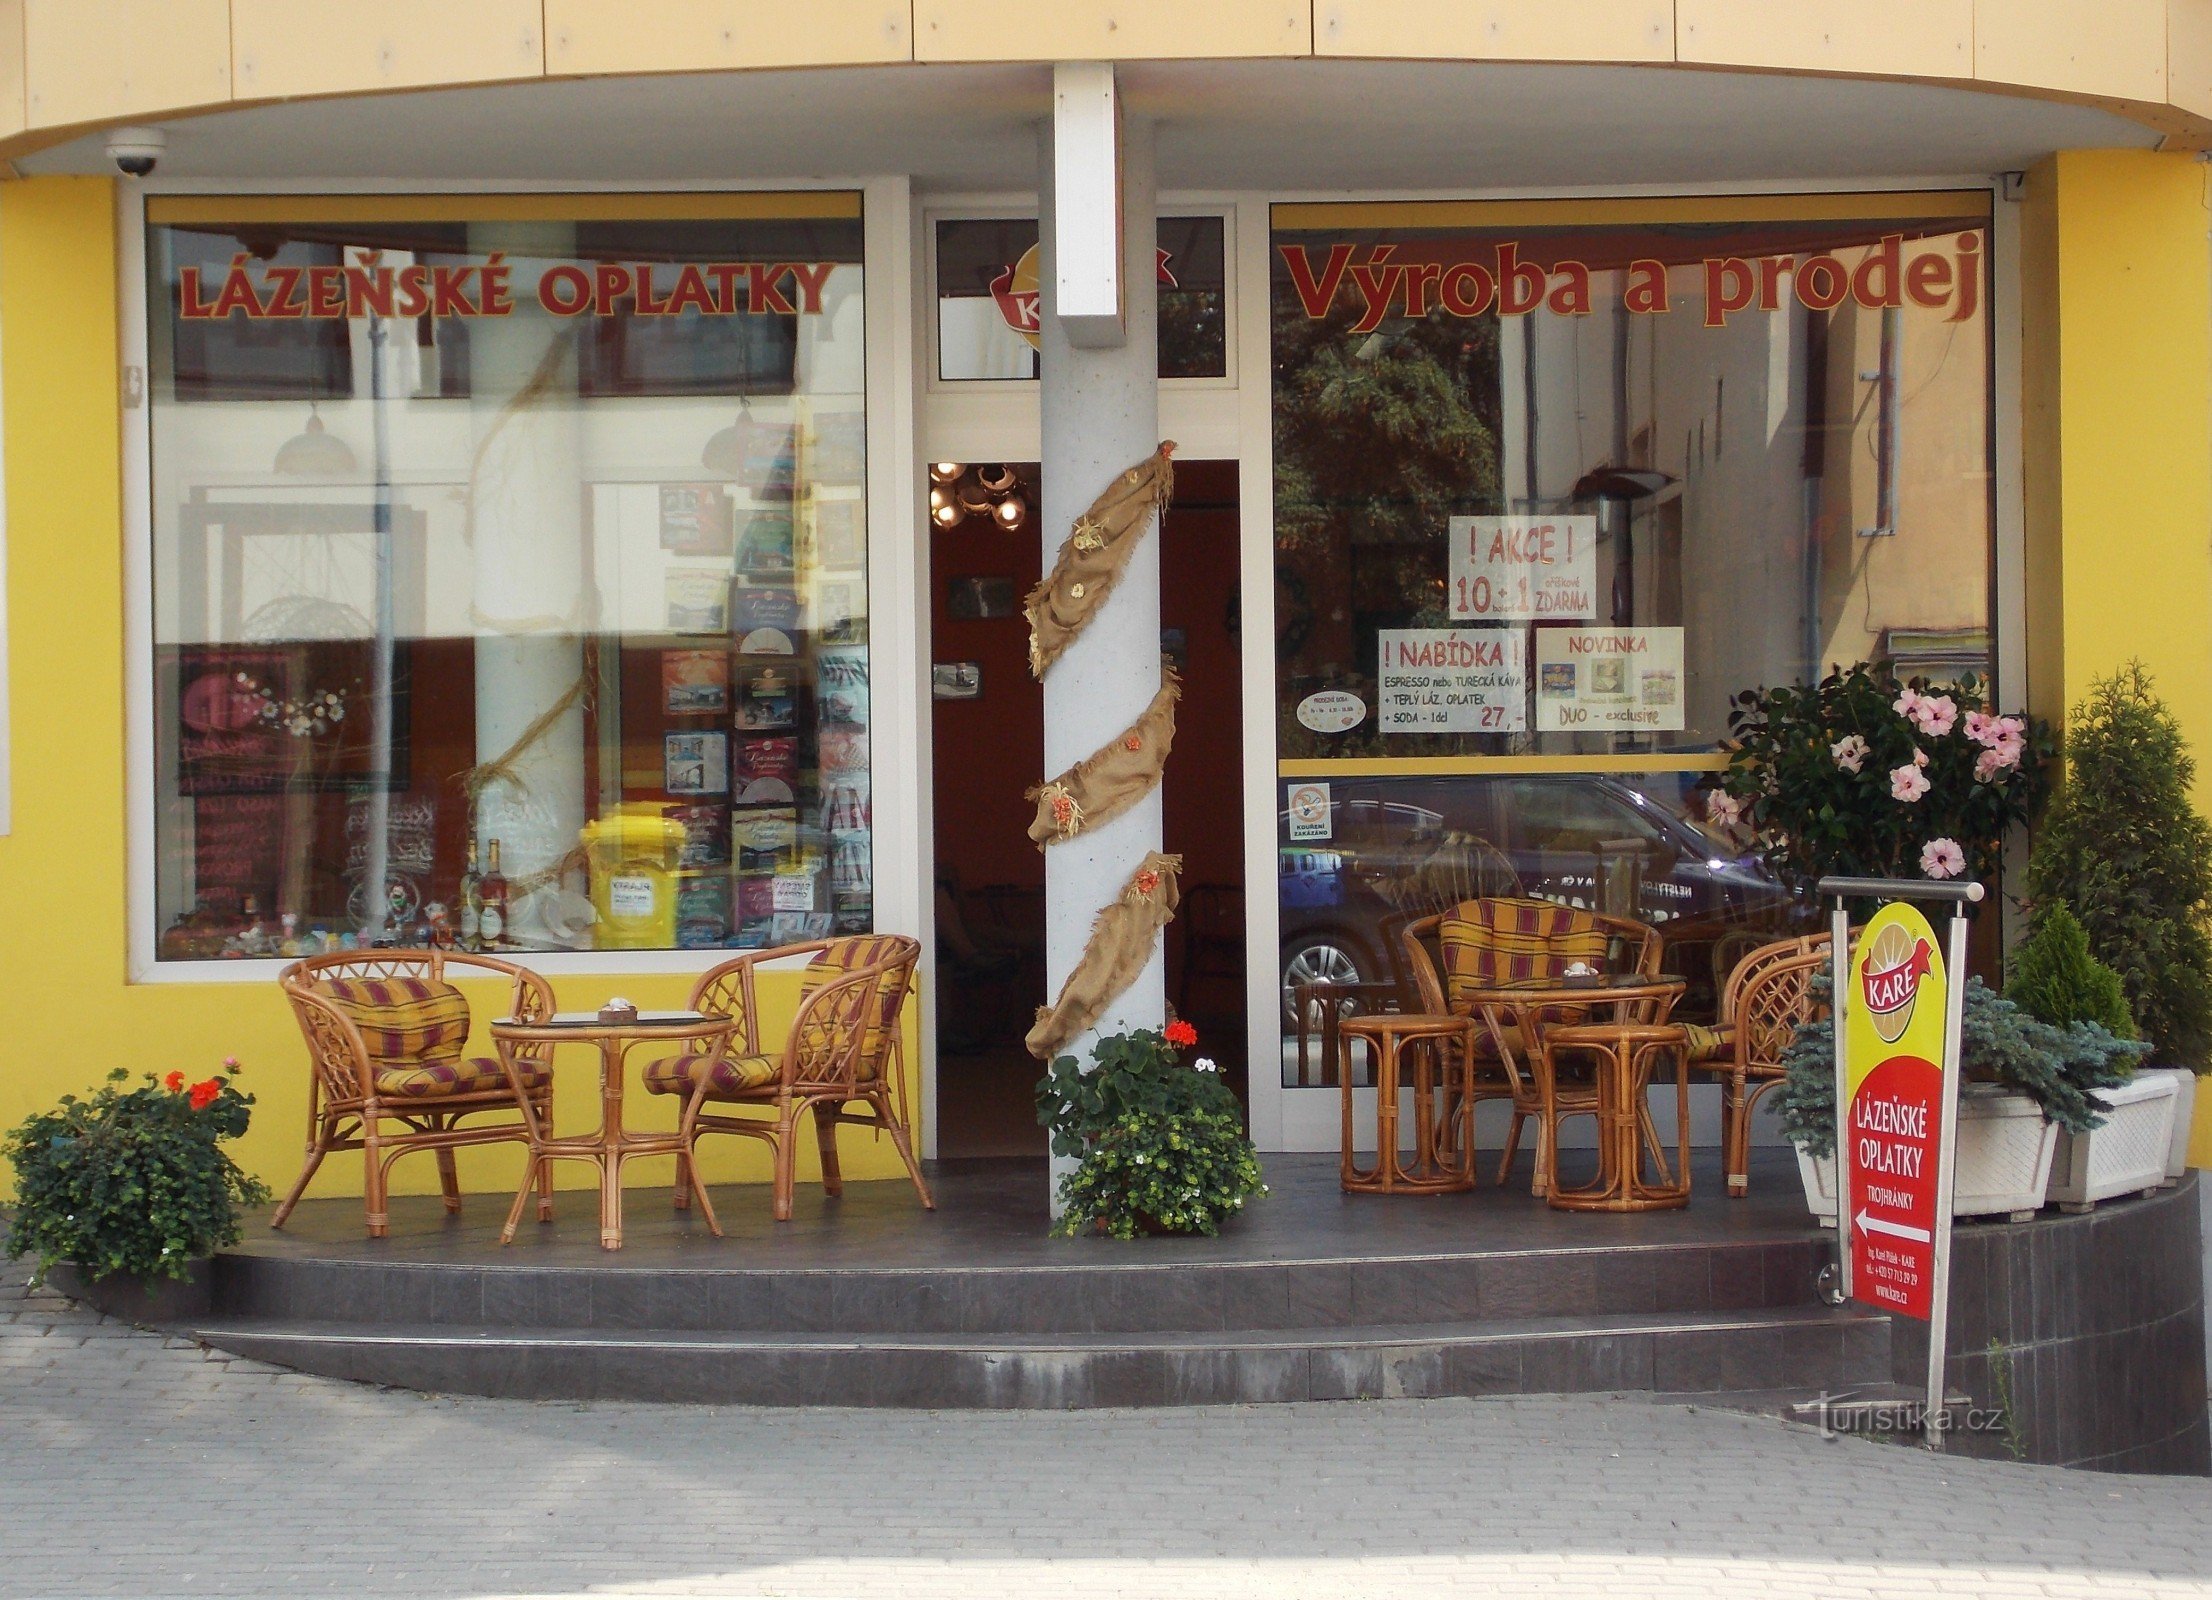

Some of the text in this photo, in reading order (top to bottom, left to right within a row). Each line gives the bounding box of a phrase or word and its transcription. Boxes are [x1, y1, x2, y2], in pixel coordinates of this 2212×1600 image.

[178, 252, 836, 319] LÁZEŇSKÉ OPLATKY
[1278, 232, 1984, 334] Výroba a prodej
[1488, 525, 1556, 564] AKCE
[1457, 576, 1491, 613] 10
[1518, 576, 1529, 613] 1
[1536, 590, 1589, 612] ZDARMA
[1400, 632, 1503, 668] NABÍDKA
[1569, 636, 1648, 654] NOVINKA
[1385, 672, 1521, 688] ESPRESSO nebo TURECKÁ KÁVA
[1394, 690, 1420, 706] TEPLÝ
[1422, 691, 1442, 706] LÁZ.
[1446, 694, 1486, 705] OPLATEK
[1393, 713, 1418, 723] SODA
[1559, 704, 1588, 726] DUO
[1605, 707, 1660, 725] exclusive
[1869, 963, 1915, 1007] KARE
[1856, 1091, 1927, 1139] LÁZEŇSKÉ
[1860, 1137, 1923, 1179] OPLATKY
[1867, 1185, 1914, 1211] TROJHRÁNKY
[1894, 1269, 1903, 1283] 713
[1901, 1254, 1916, 1268] KARE
